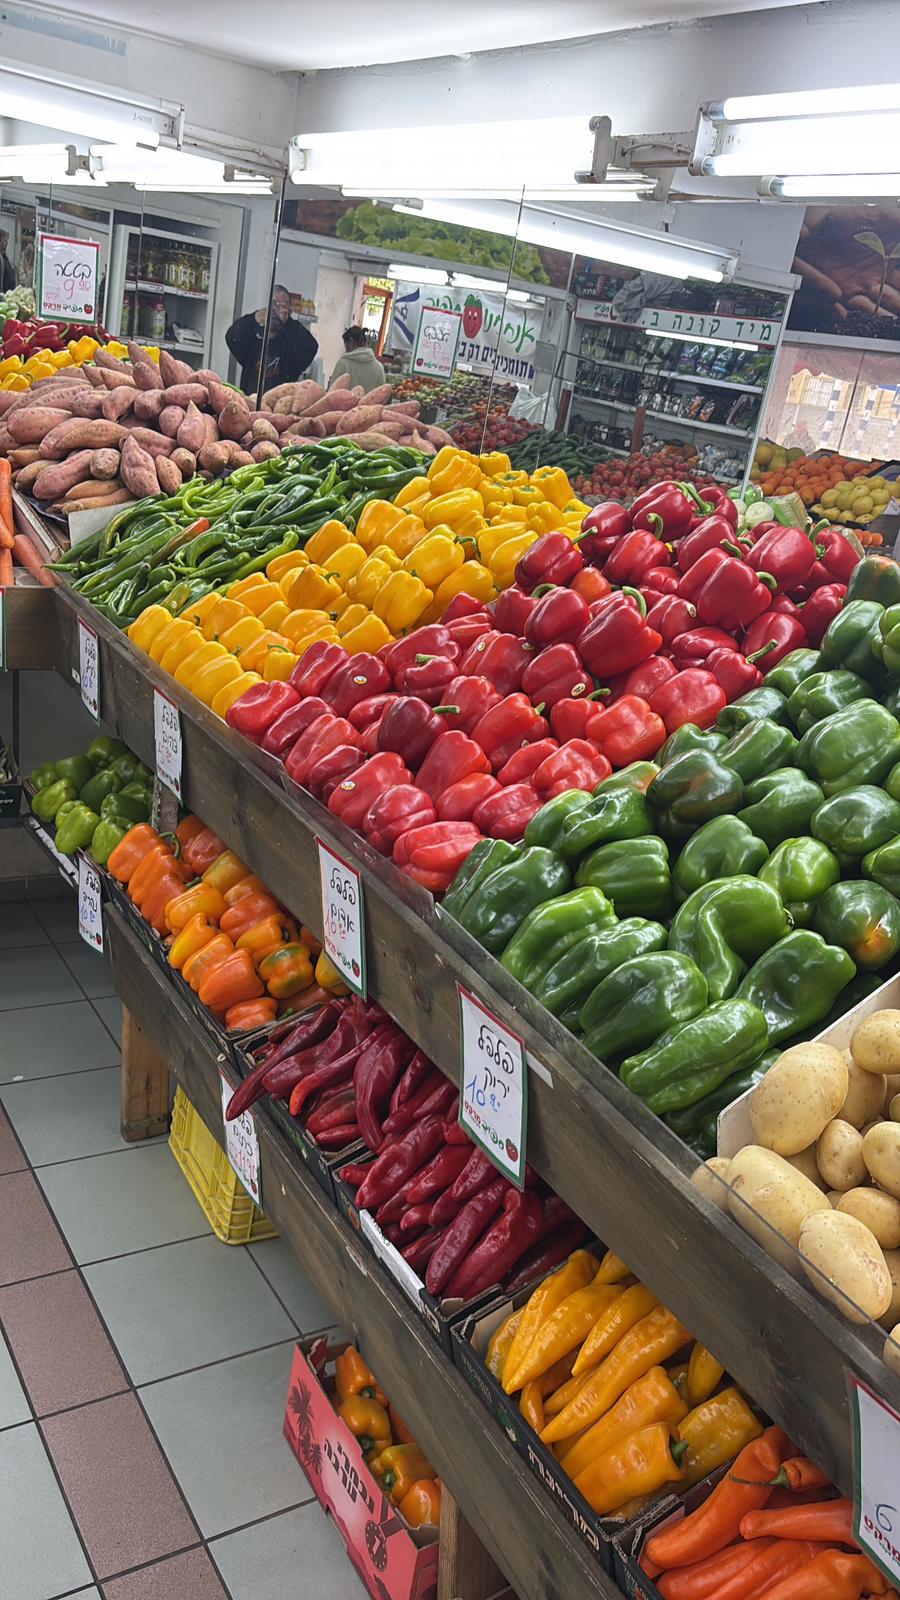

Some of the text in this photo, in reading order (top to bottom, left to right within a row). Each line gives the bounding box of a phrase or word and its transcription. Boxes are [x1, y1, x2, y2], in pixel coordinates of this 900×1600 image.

[672, 314, 721, 337] קונה
[330, 867, 356, 905] פלפל
[331, 903, 355, 933] אדום
[478, 1024, 514, 1075] פלפל
[483, 1067, 510, 1099] ירוק
